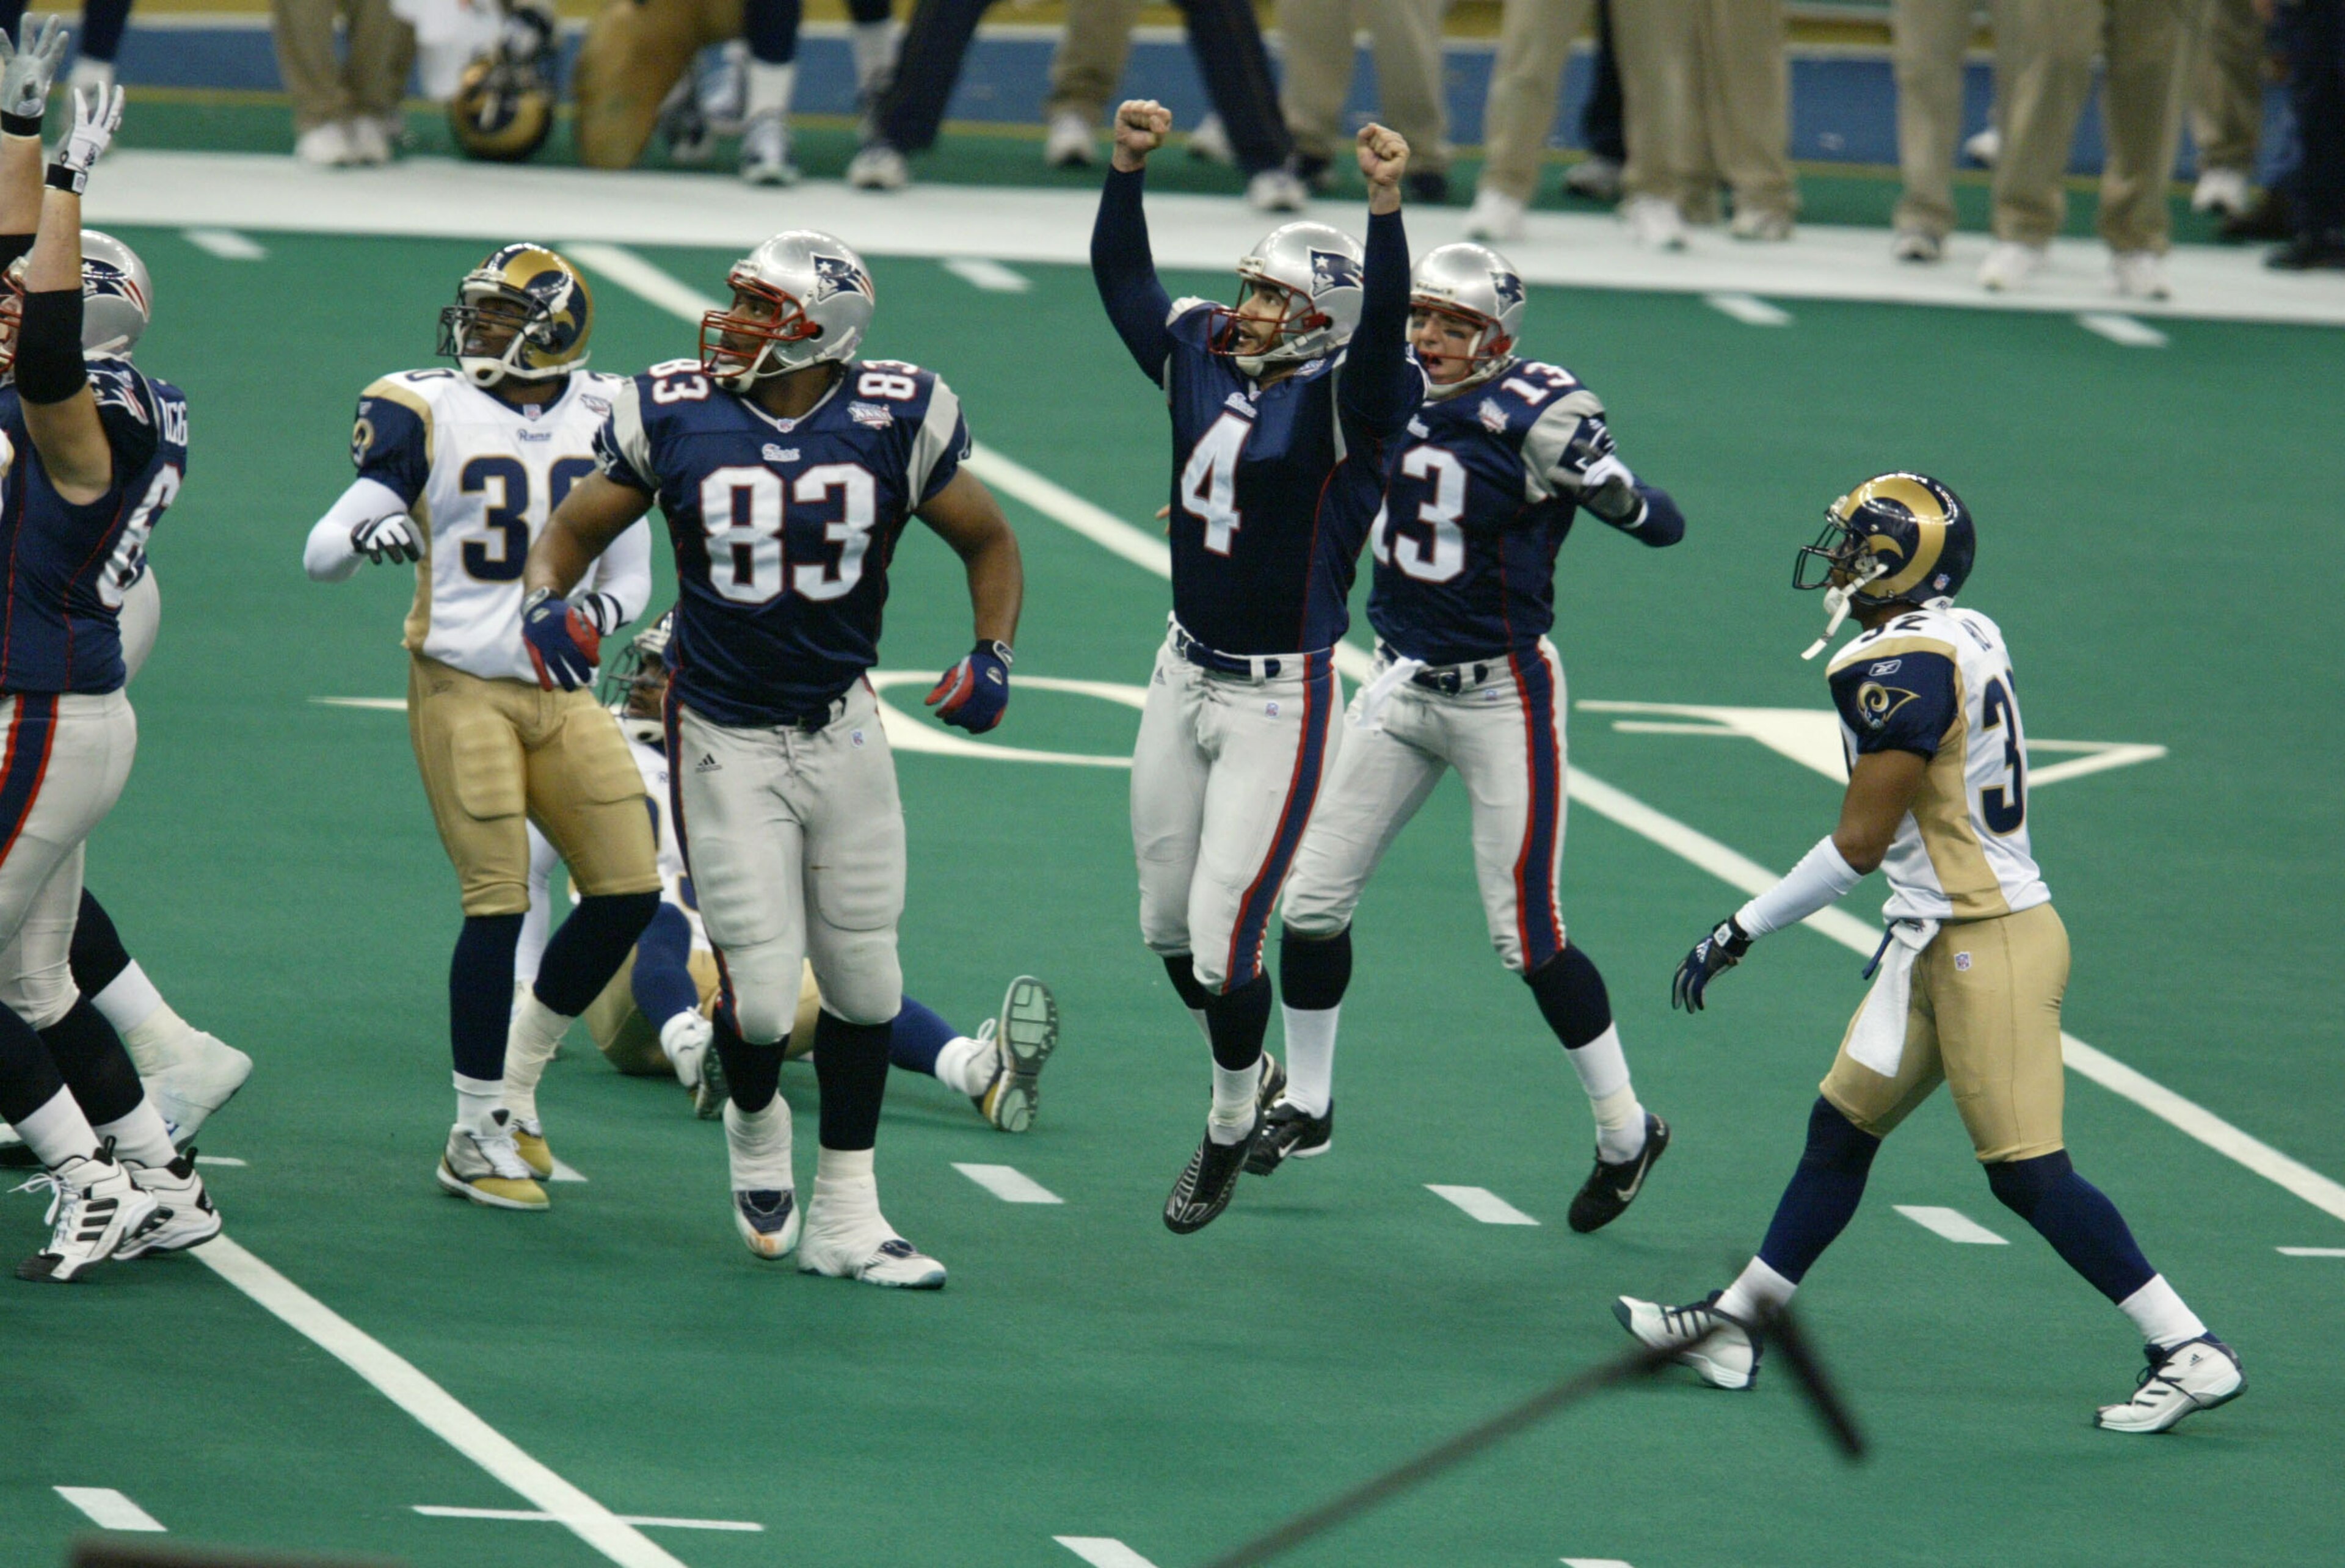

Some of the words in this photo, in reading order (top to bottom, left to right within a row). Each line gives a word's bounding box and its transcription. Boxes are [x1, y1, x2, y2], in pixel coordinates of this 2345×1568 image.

[649, 358, 710, 405] 83
[1500, 361, 1577, 405] 13
[700, 463, 876, 603] 83
[1180, 412, 1252, 557] 4
[1979, 667, 2024, 838] 3
